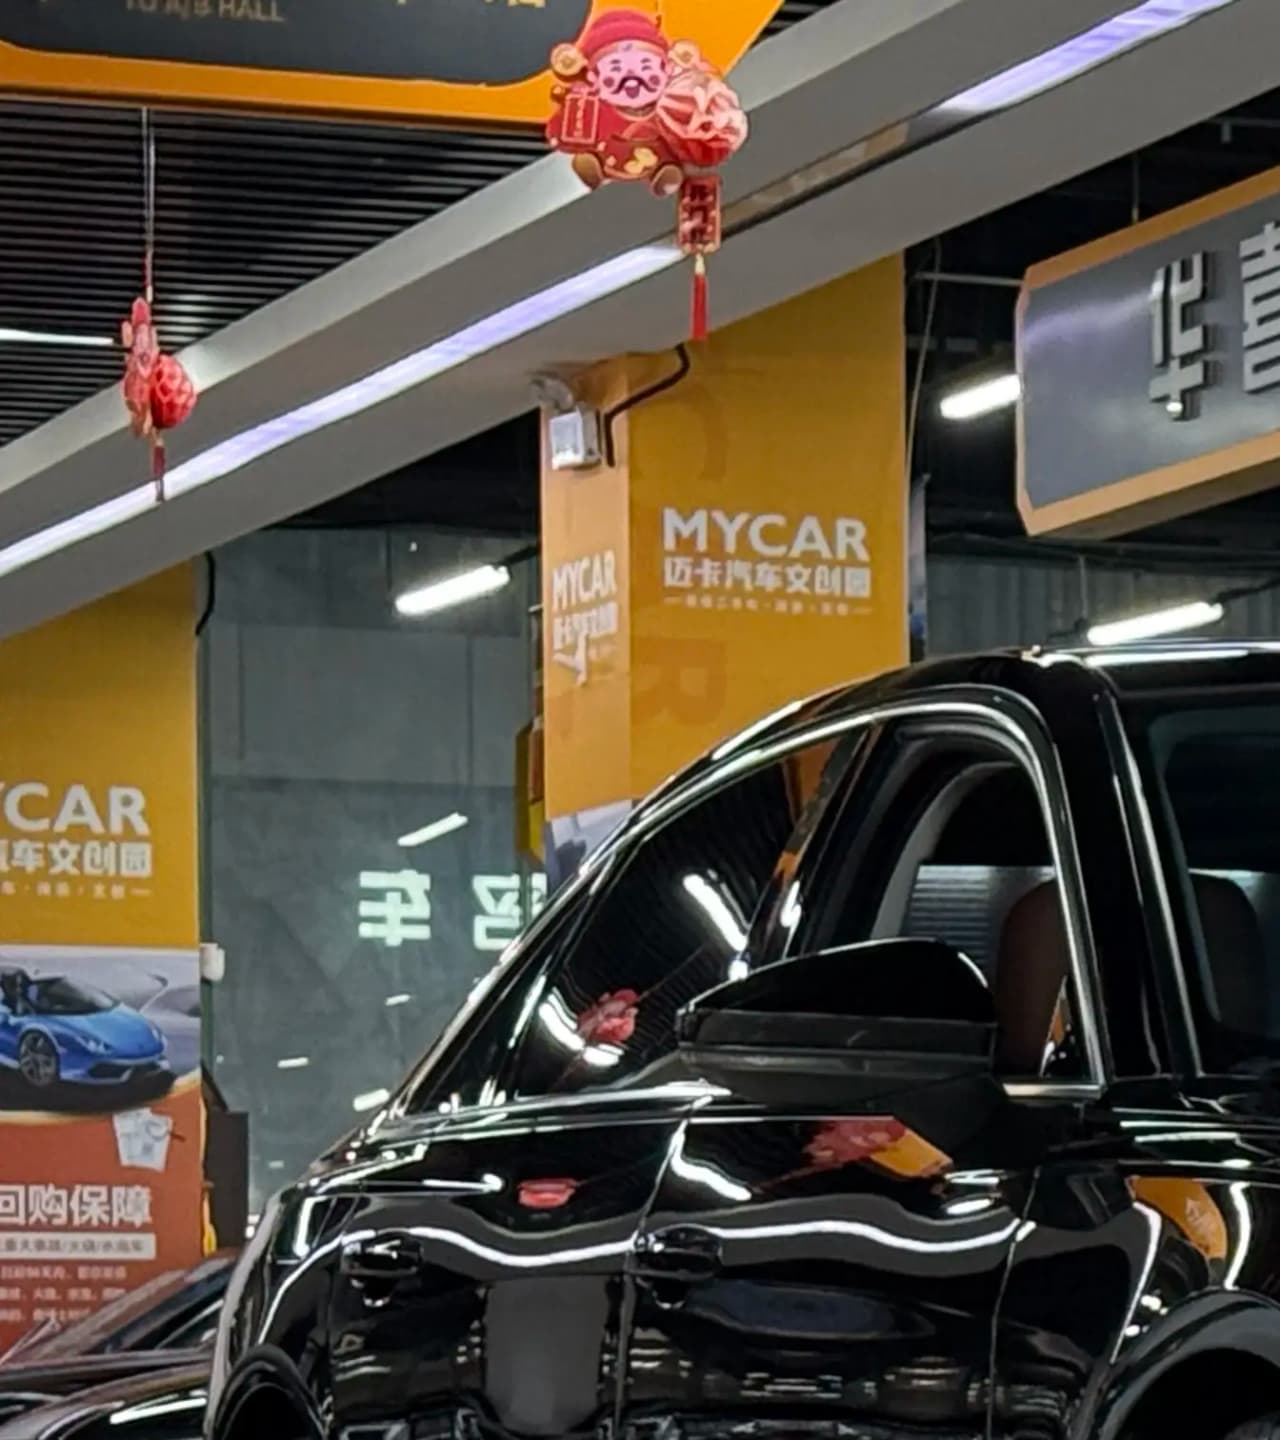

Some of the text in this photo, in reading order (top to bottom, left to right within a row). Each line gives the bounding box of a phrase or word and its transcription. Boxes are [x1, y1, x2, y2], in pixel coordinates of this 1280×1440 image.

[662, 507, 870, 562] MYCAR
[552, 550, 617, 612] MYCAR
[663, 556, 871, 599] 迈卡汽车文创园
[0, 781, 150, 836] CAR
[0, 837, 152, 879] 车文创园
